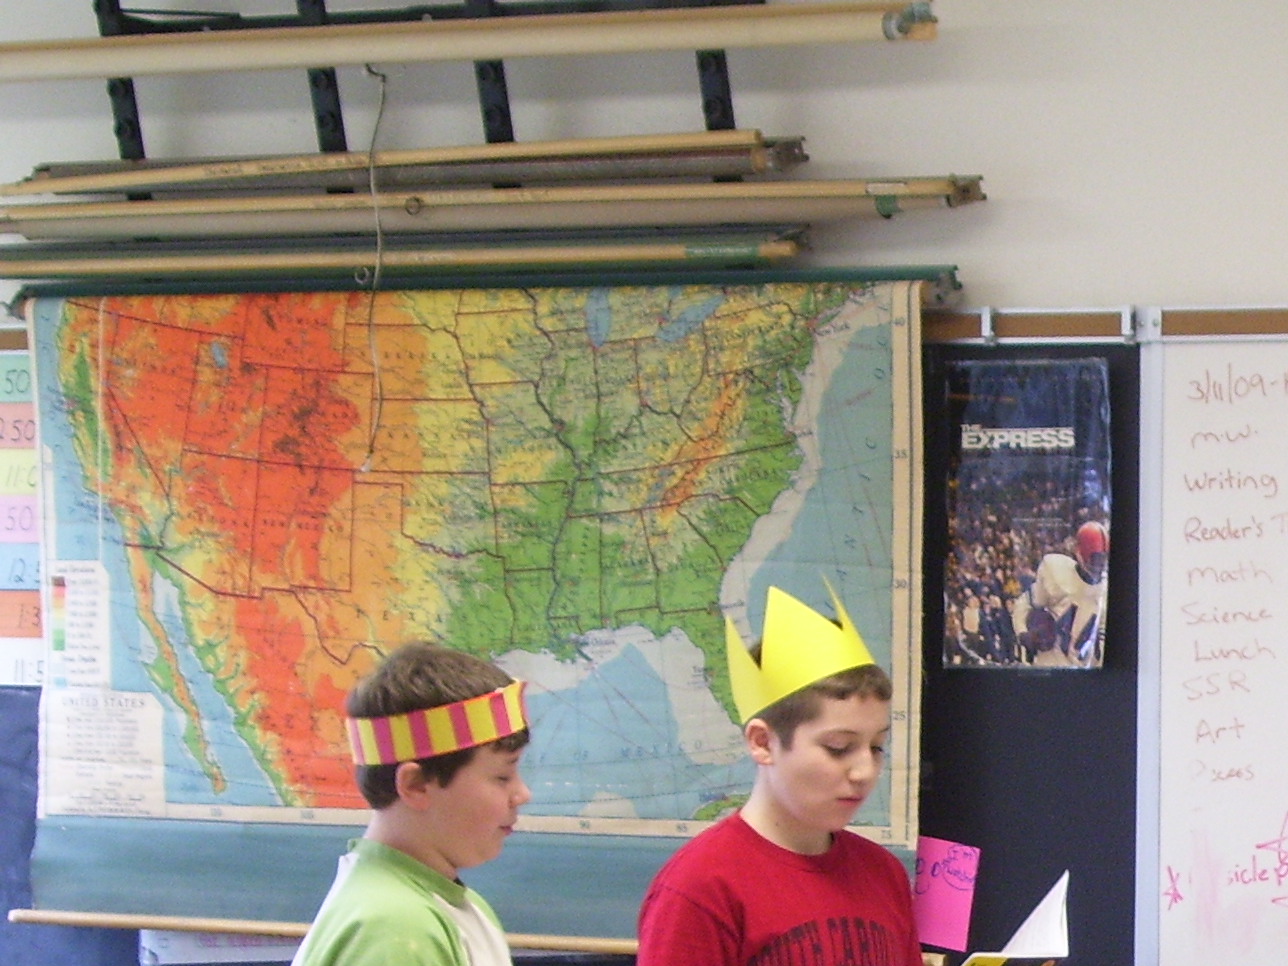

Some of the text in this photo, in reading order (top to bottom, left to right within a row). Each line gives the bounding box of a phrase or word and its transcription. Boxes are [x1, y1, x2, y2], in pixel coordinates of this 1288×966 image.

[961, 427, 1076, 450] EXPRESS
[1184, 516, 1264, 543] Reader's
[1194, 640, 1276, 663] Lunch
